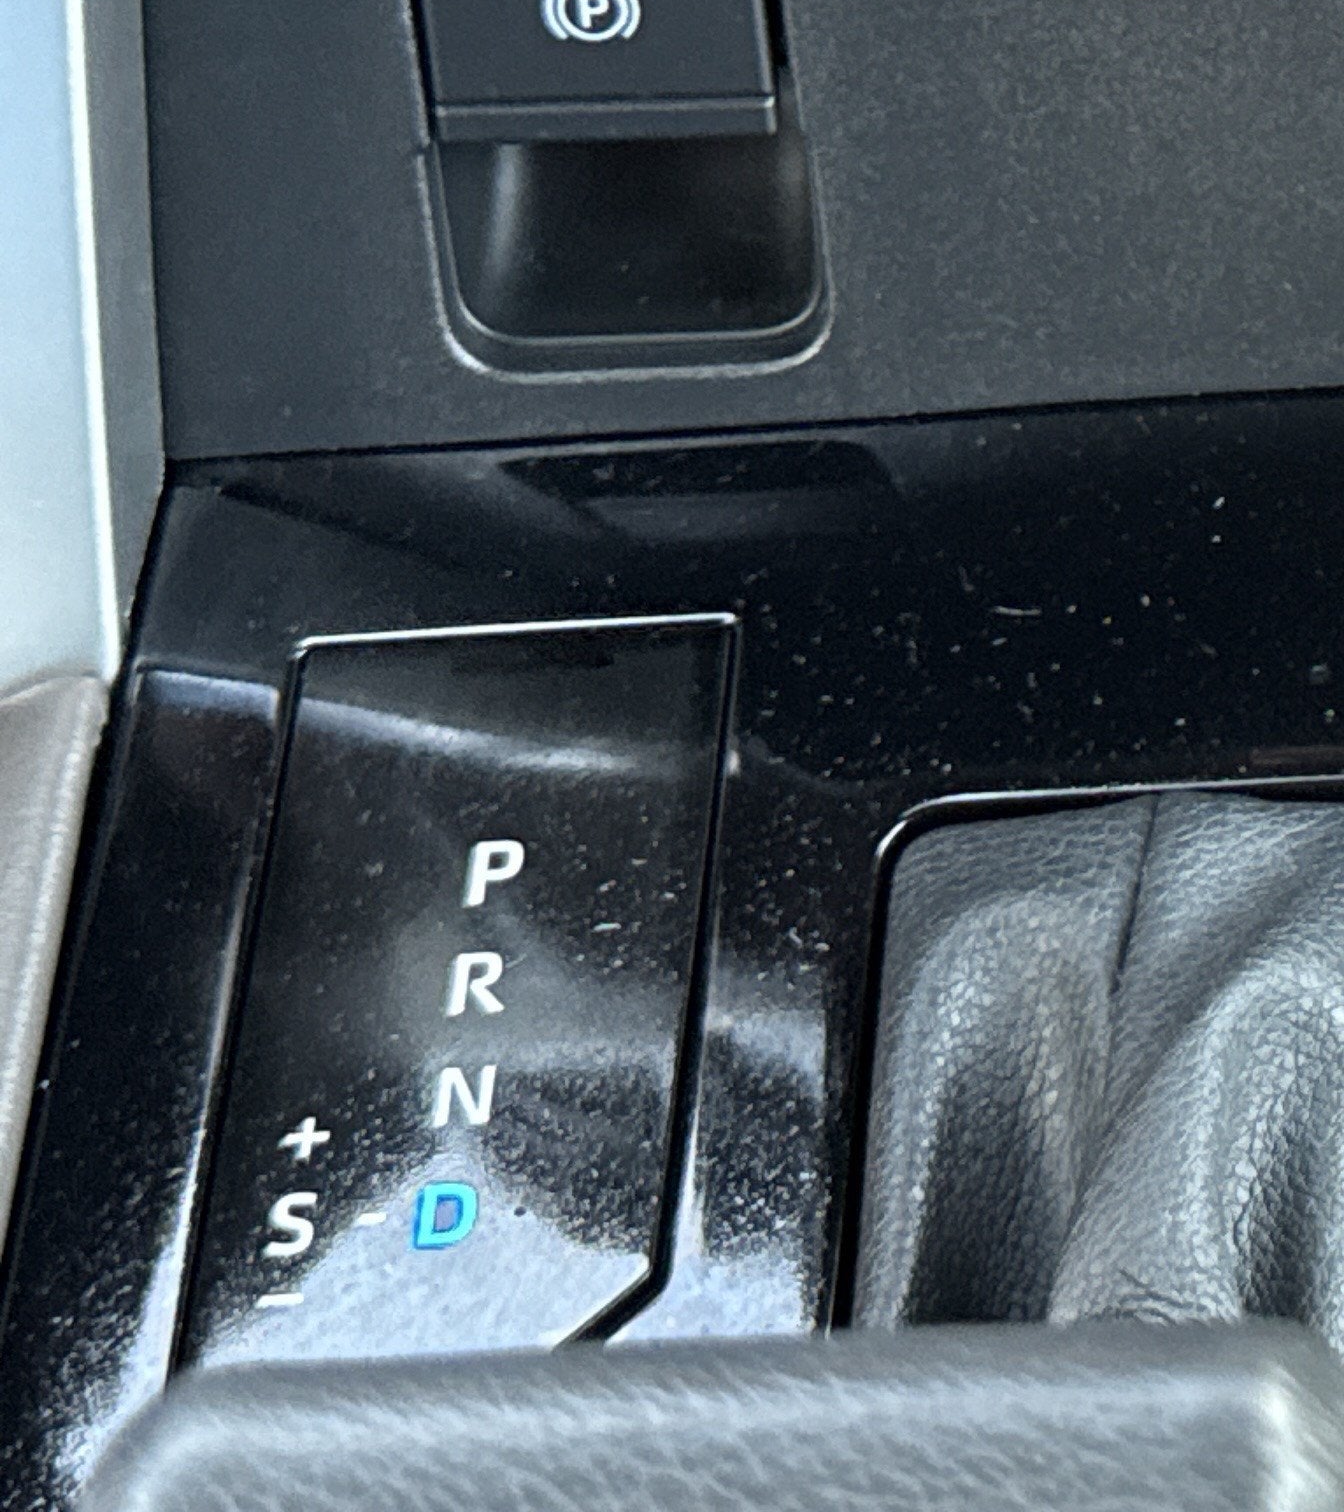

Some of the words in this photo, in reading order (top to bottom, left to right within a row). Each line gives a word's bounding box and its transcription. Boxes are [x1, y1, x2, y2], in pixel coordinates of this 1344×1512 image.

[463, 840, 524, 907] P
[444, 952, 505, 1017] R
[430, 1065, 497, 1128] N
[262, 1192, 317, 1257] S
[411, 1181, 478, 1250] D
